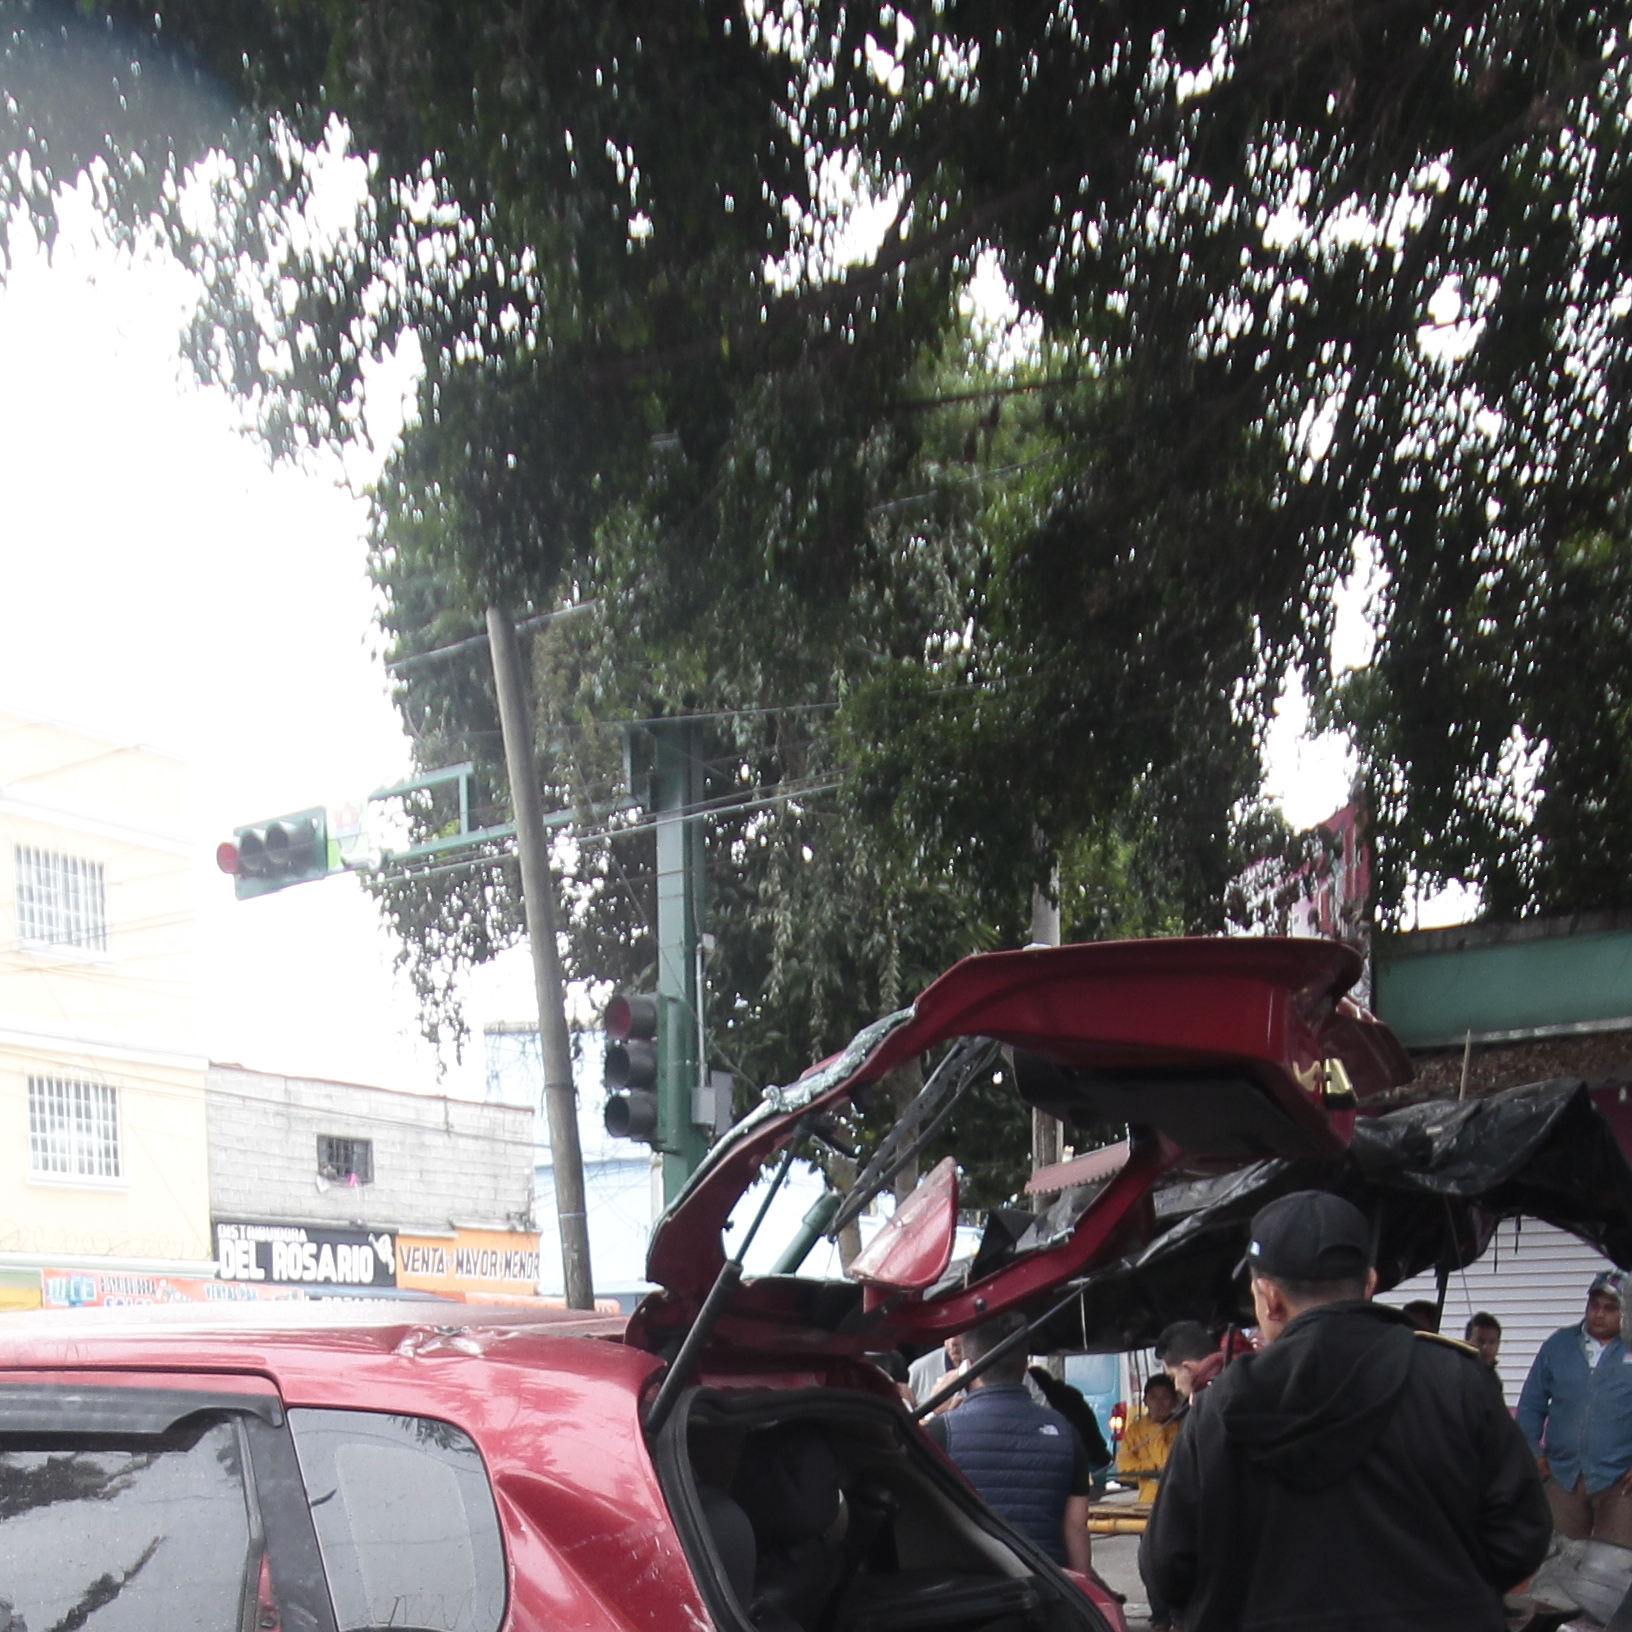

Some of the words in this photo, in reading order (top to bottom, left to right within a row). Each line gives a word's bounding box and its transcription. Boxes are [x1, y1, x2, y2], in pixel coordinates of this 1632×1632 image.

[217, 1223, 308, 1242] DISTRIBUIDORA
[218, 1240, 266, 1281] DEL
[272, 1242, 375, 1283] ROSARIO
[399, 1245, 446, 1274] VENTA
[454, 1248, 499, 1278] MAYOR
[503, 1249, 540, 1280] MENOR
